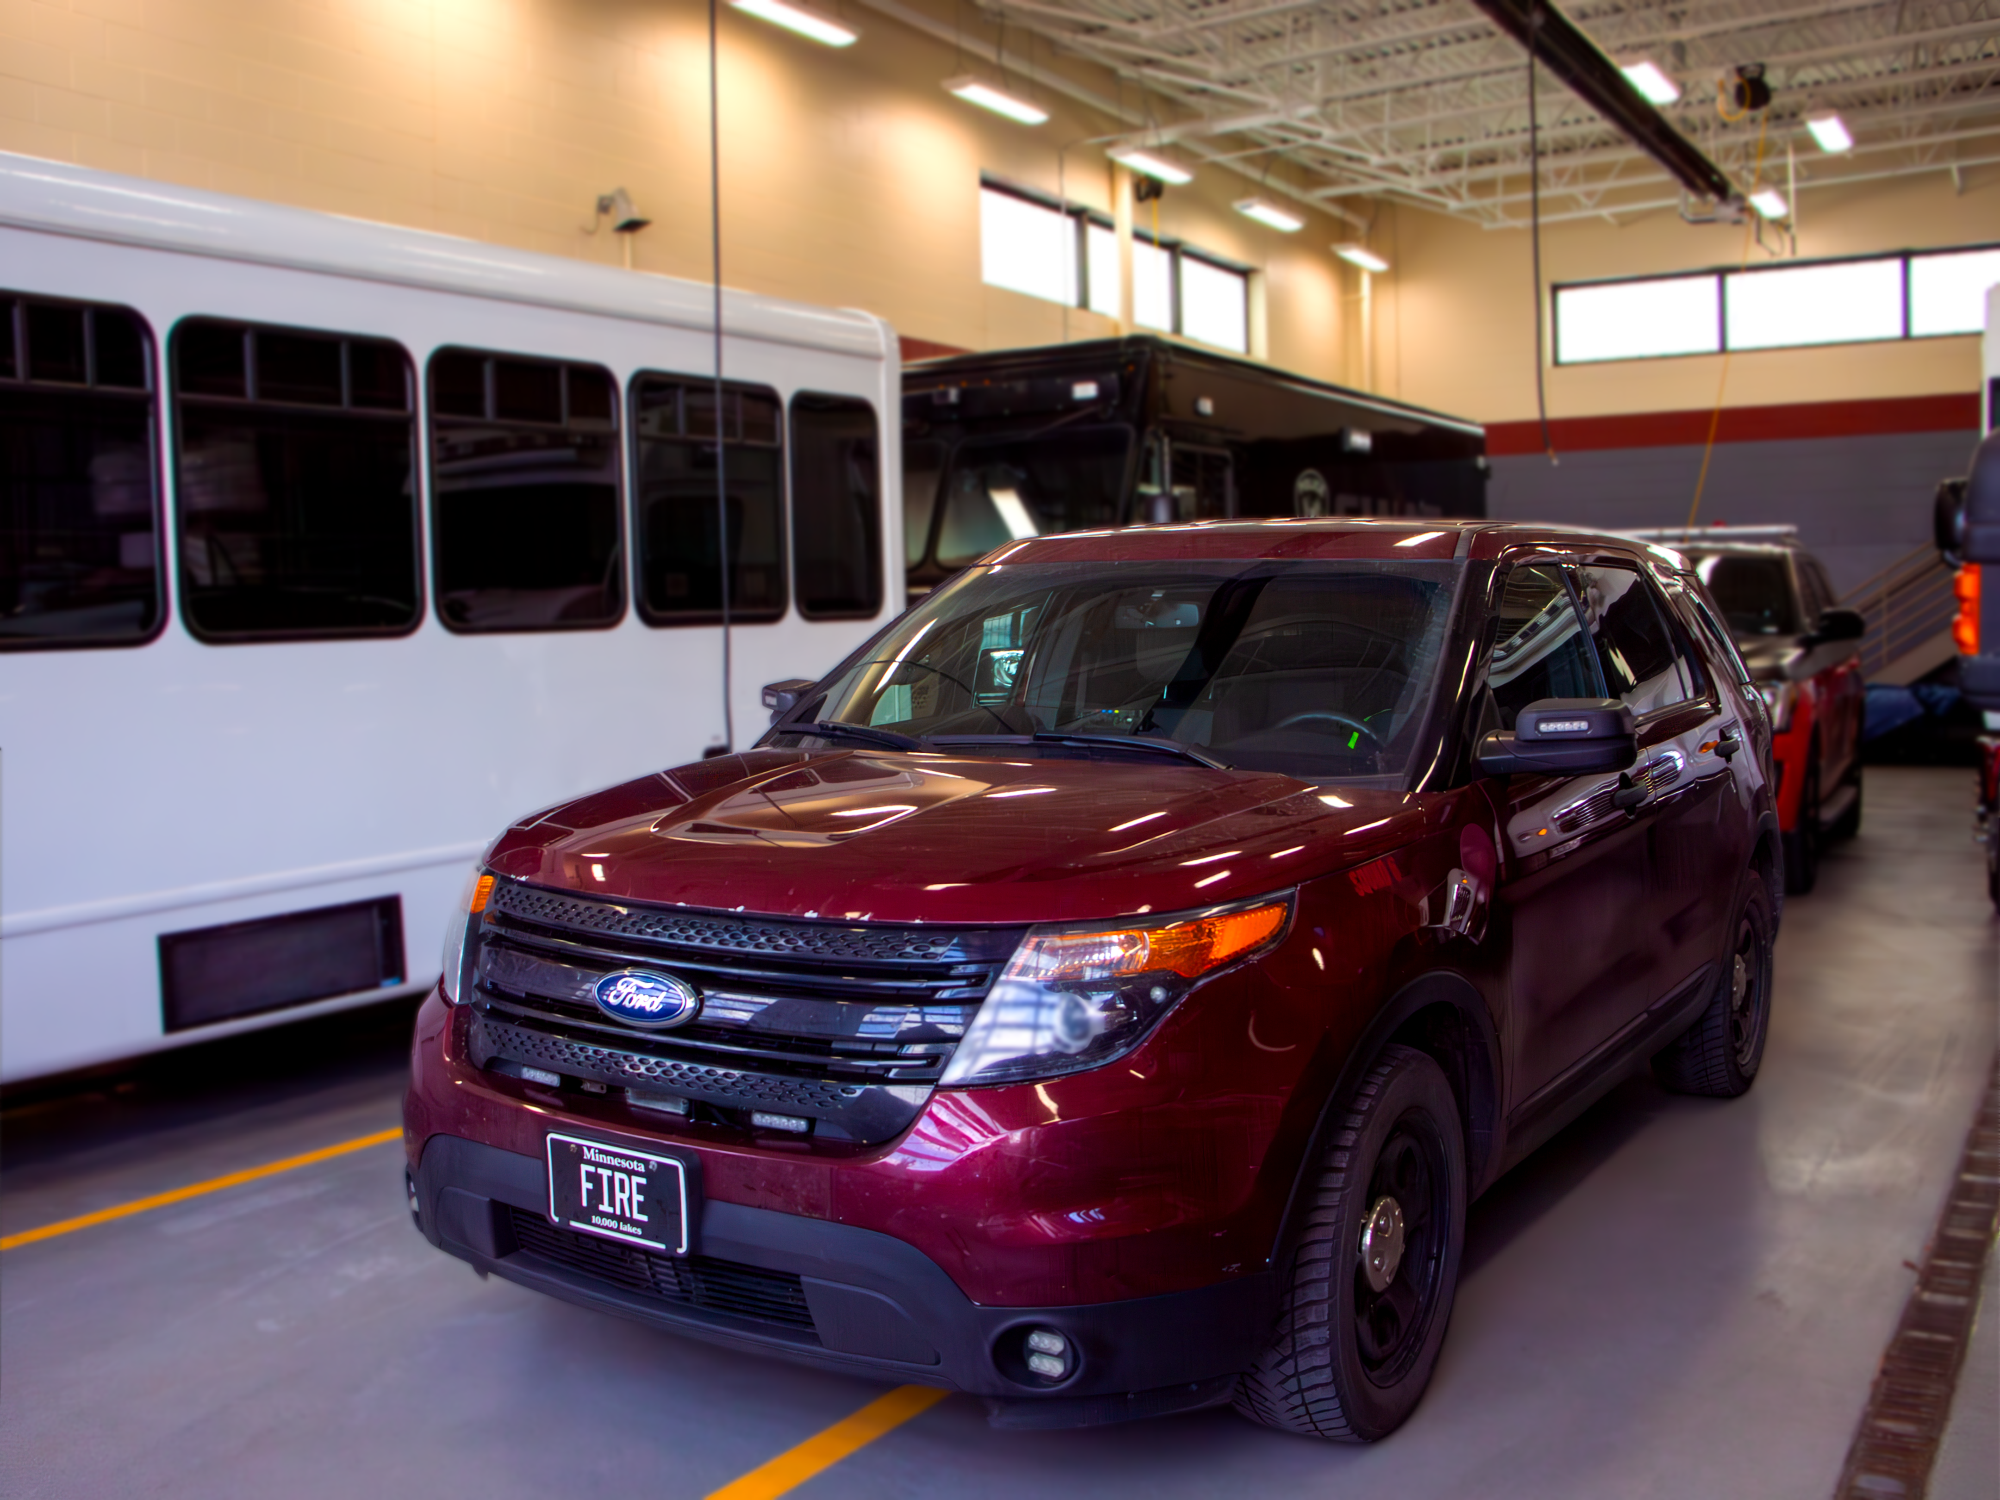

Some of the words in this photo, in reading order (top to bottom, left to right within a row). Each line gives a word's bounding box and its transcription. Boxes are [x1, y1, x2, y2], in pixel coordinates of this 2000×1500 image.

[607, 977, 667, 1013] Ford
[582, 1146, 646, 1172] Minnesota
[580, 1163, 648, 1222] FIRE
[591, 1215, 618, 1229] 10,000
[619, 1221, 642, 1235] lakes
